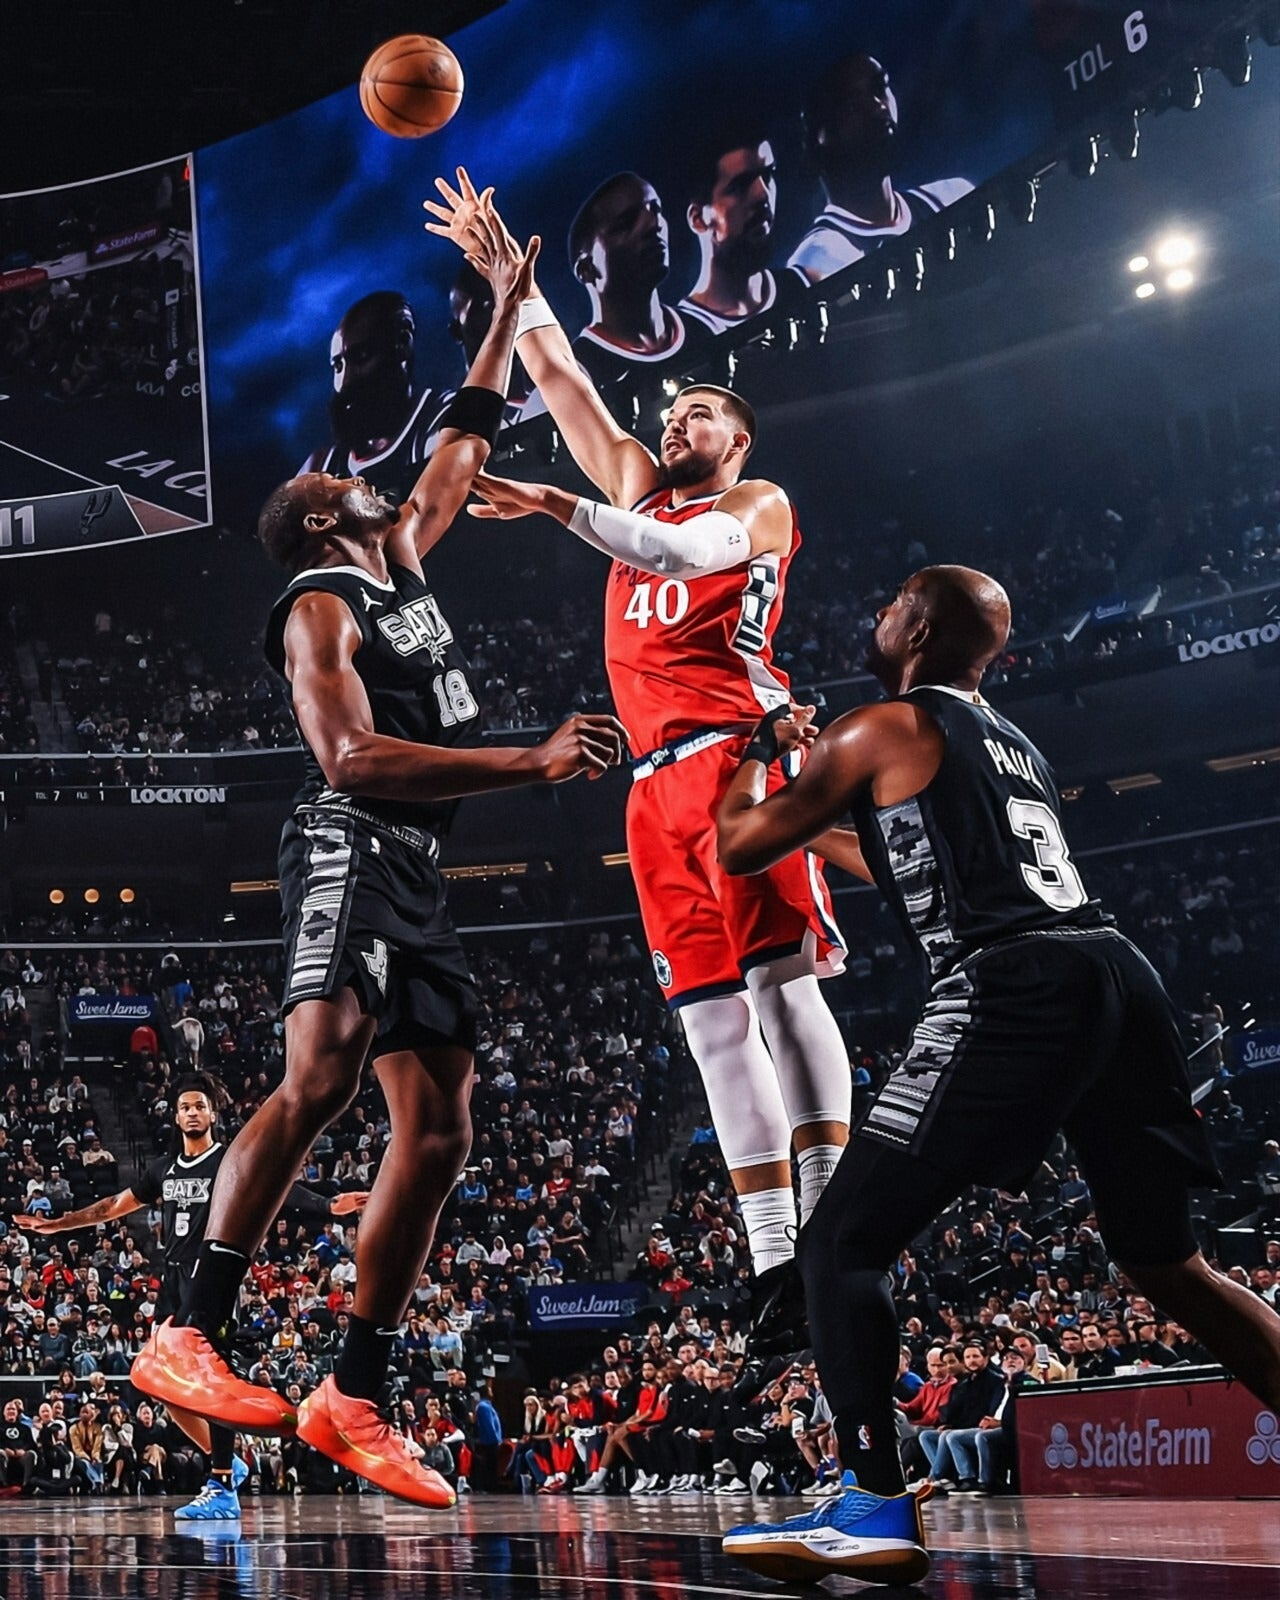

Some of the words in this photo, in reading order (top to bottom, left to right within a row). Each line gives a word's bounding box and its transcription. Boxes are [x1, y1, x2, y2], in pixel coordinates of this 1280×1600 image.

[1064, 44, 1112, 91] TOL
[1123, 10, 1148, 53] 6
[105, 450, 176, 478] LA
[623, 579, 689, 629] 40
[1178, 621, 1280, 662] LOCKTO
[433, 669, 479, 727] 18
[983, 738, 1047, 798] PAUL
[53, 790, 60, 801] 7
[99, 790, 104, 801] 1
[131, 788, 226, 804] LOCKTON
[1006, 795, 1088, 912] 3
[162, 1178, 212, 1203] SATX
[175, 1212, 190, 1237] 5
